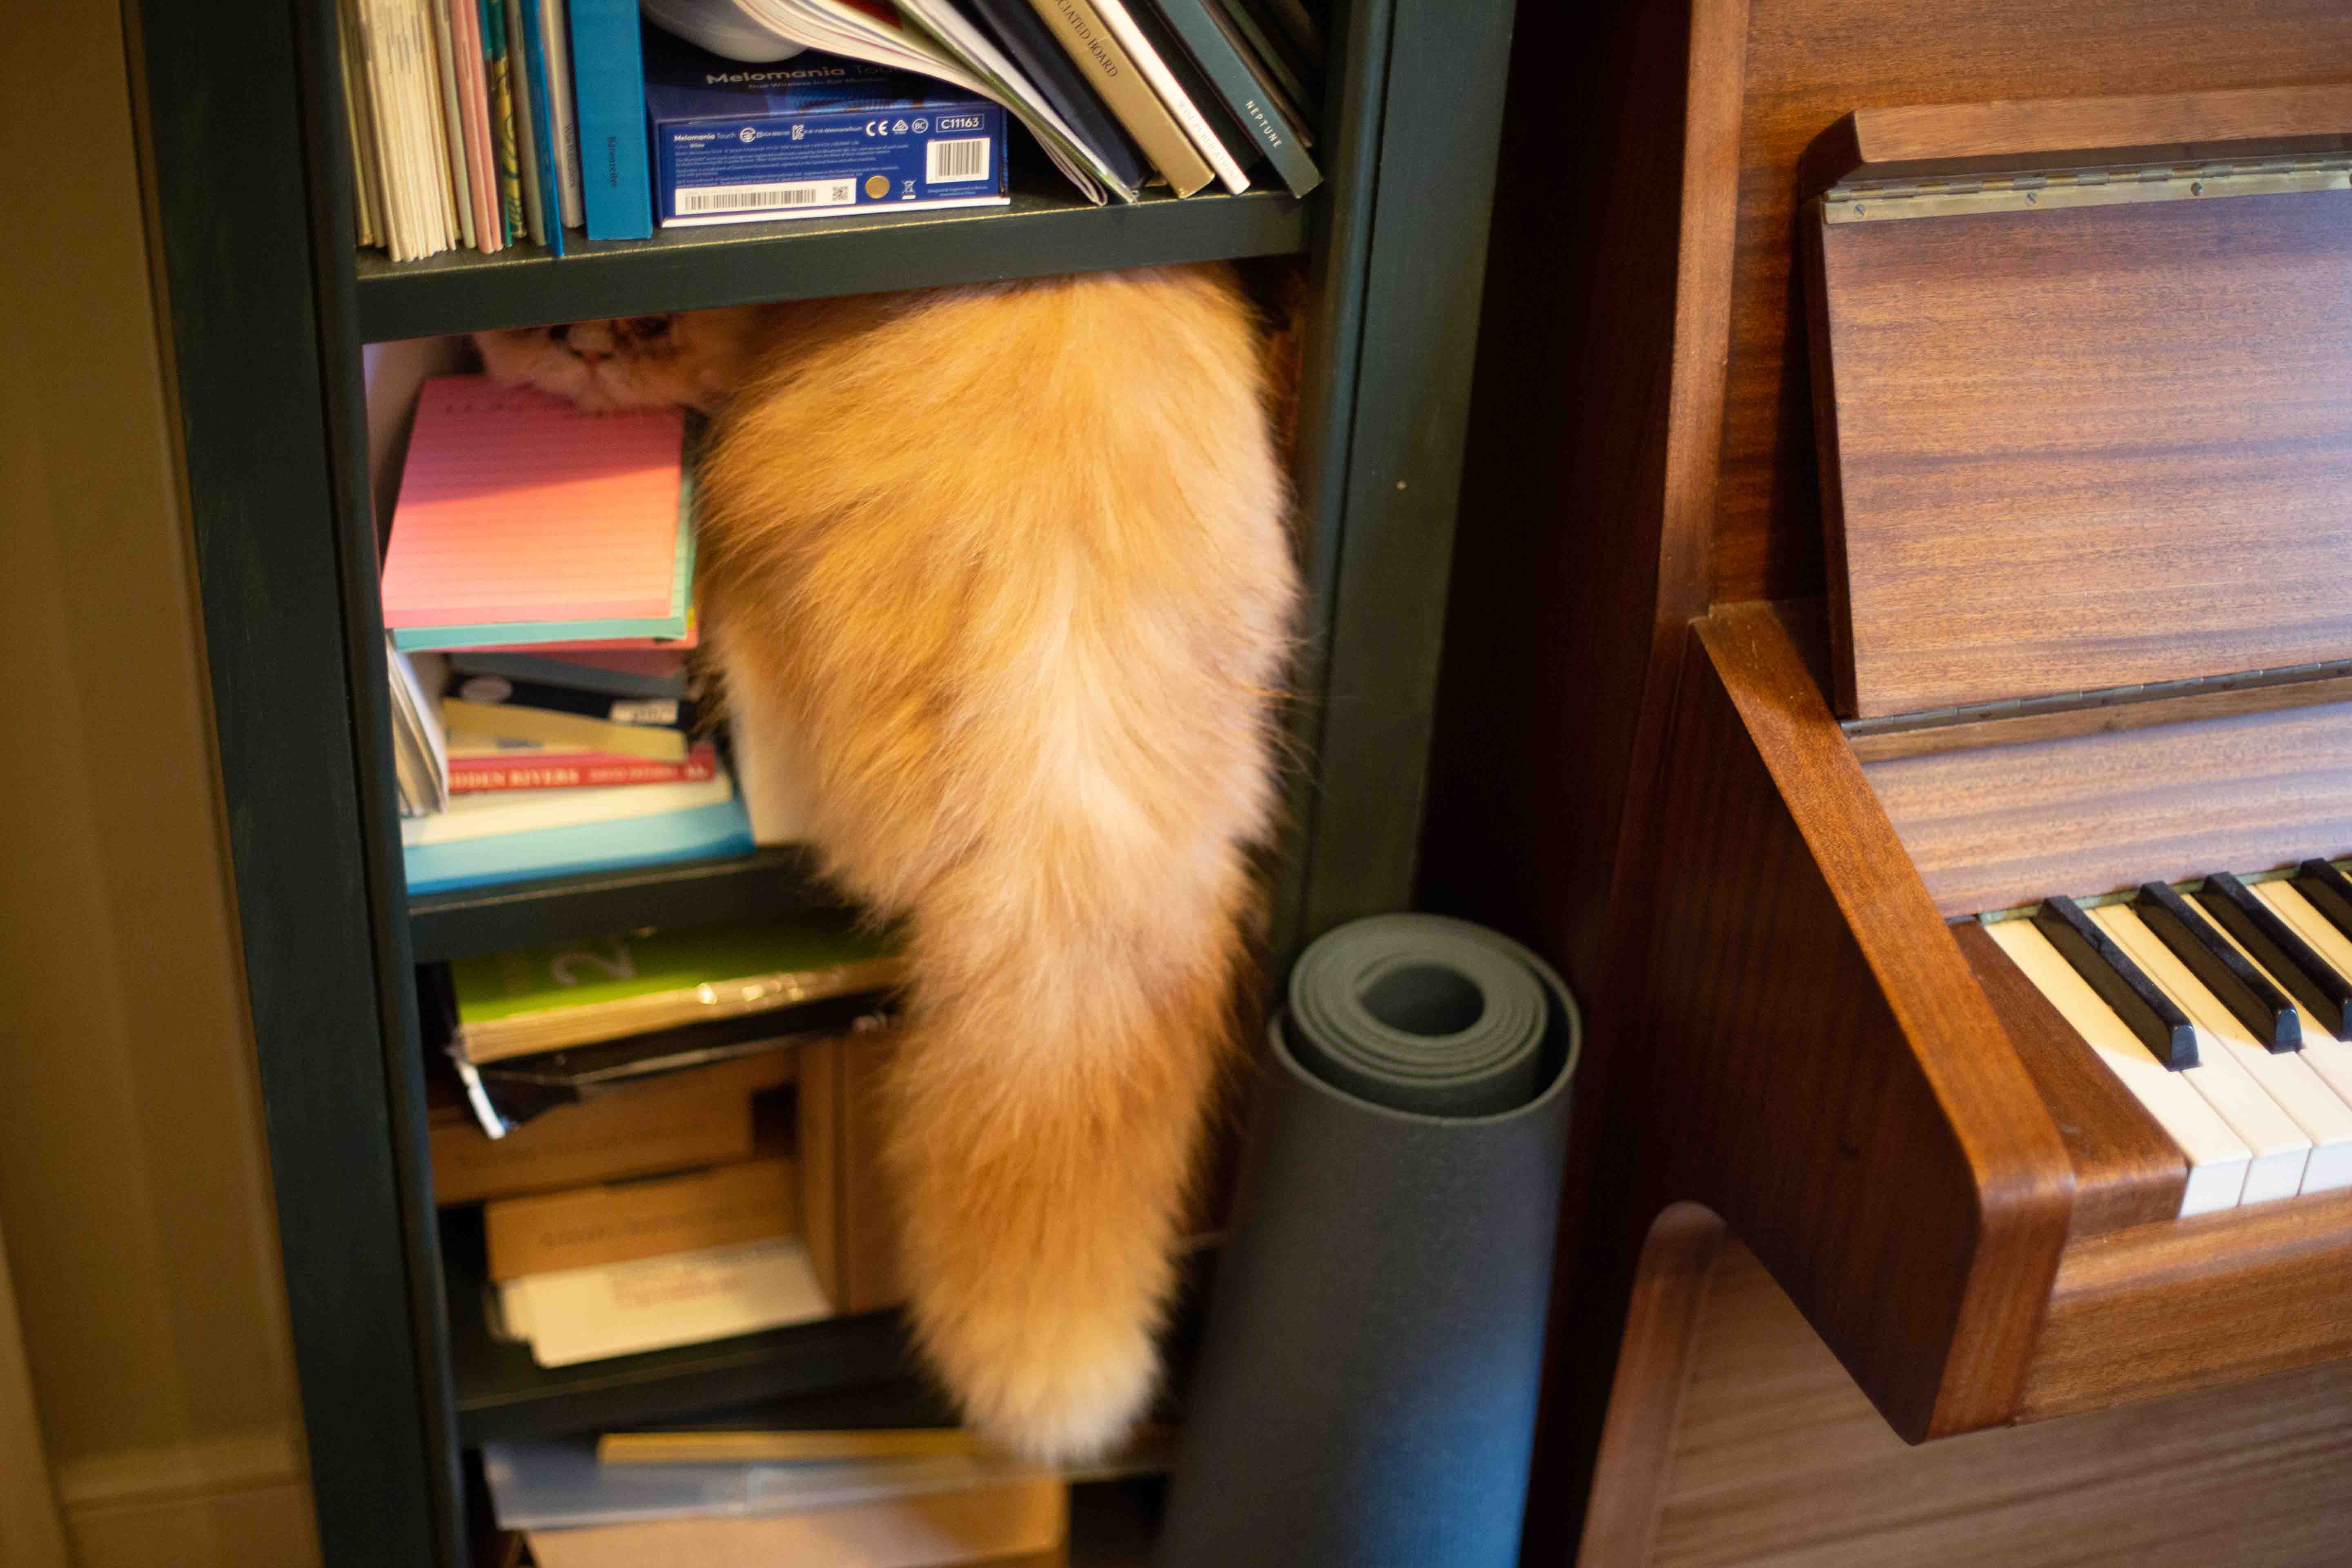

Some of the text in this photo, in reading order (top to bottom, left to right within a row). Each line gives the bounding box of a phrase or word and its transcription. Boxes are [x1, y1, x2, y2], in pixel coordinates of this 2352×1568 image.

[1087, 38, 1118, 77] BOARD
[706, 67, 846, 85] Melomania
[866, 120, 888, 136] CE
[940, 117, 979, 129] C11163
[1245, 100, 1282, 149] NEPTUNE
[674, 133, 715, 142] Melomania
